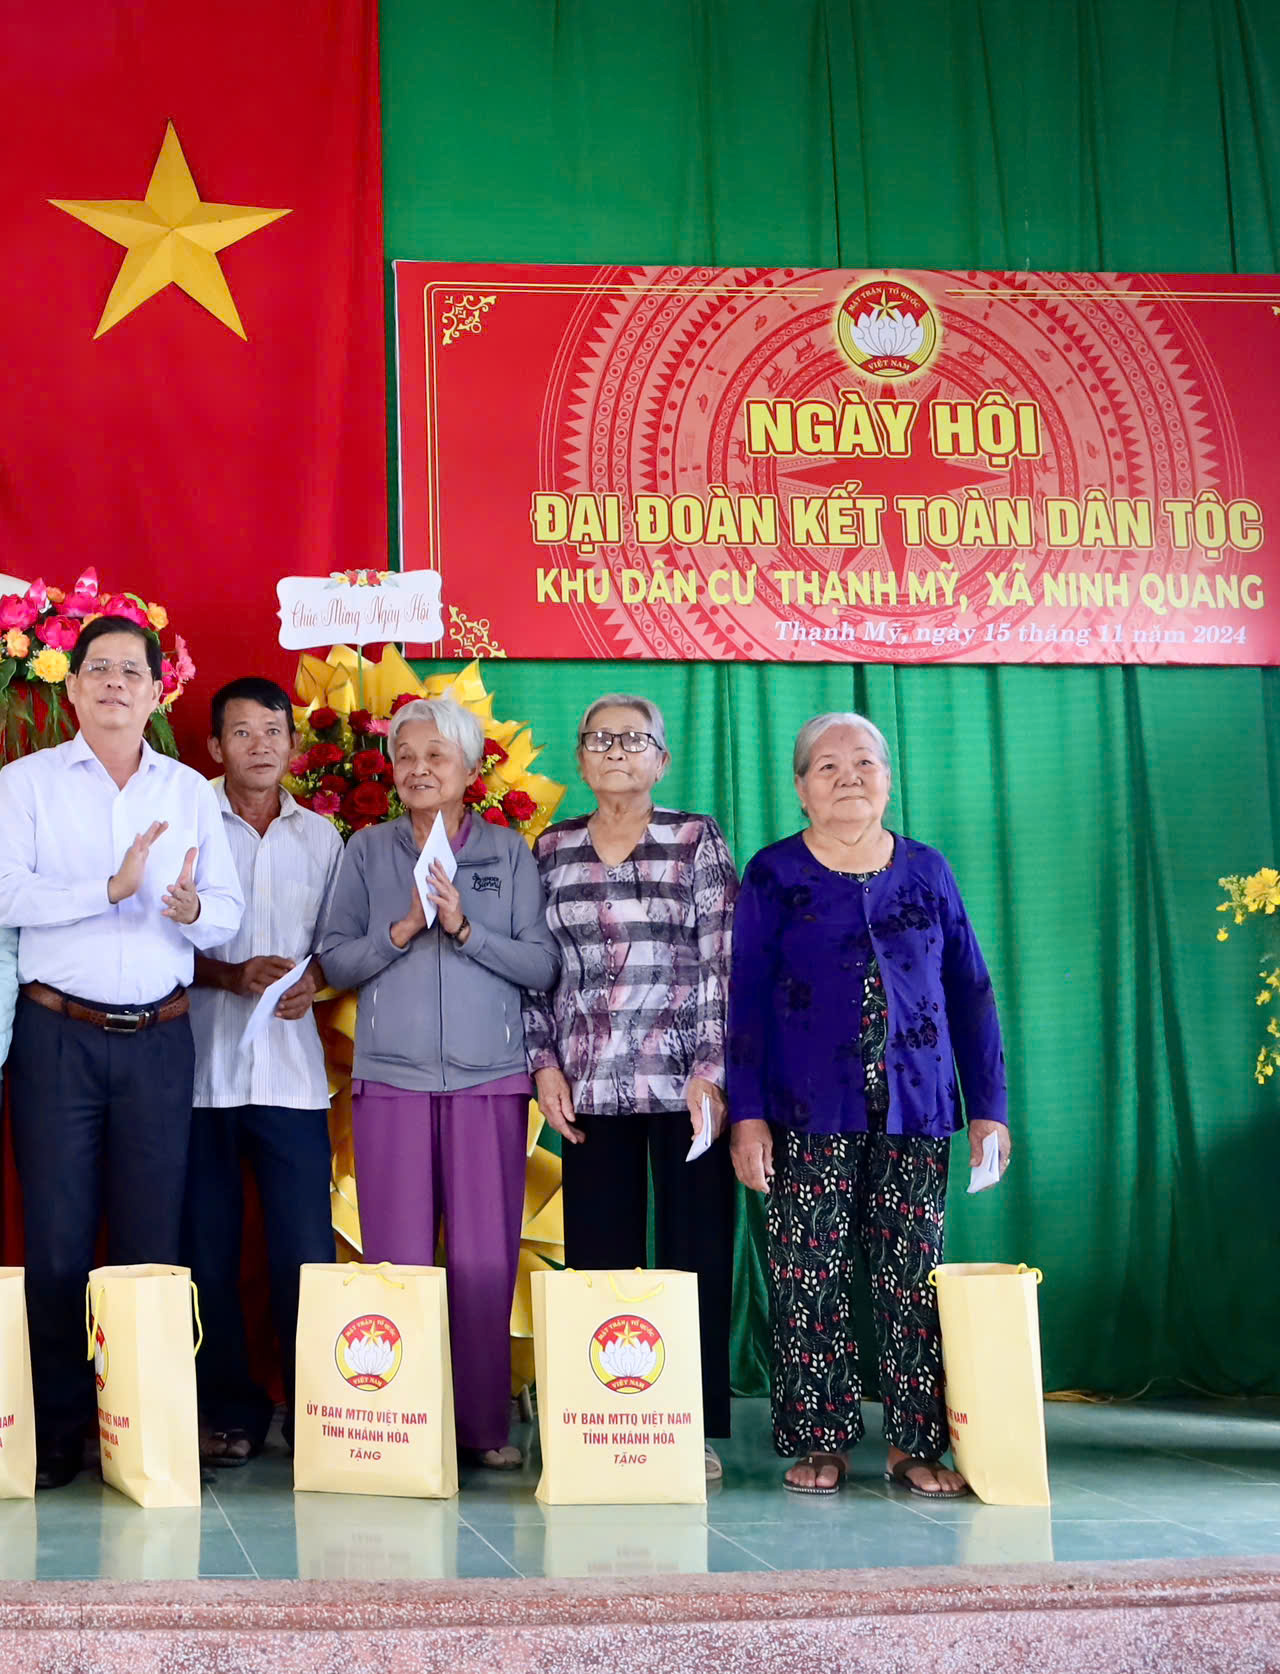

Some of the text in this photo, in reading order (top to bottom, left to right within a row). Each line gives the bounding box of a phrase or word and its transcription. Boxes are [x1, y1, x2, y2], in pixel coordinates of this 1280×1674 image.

[868, 360, 910, 370] VIỆT NAM
[746, 389, 1042, 470] NGÀY HỘI
[532, 481, 1264, 561] ĐẠI ĐOÀN KẾT TOÀN DÂN TỘC
[536, 560, 1265, 615] KHU DÂN CƯ THẠNH MỸ, XÃ NINH QUANG
[775, 621, 1247, 646] Thạnh Mỹ, ngày 15 tháng 11 năm 2024
[306, 1400, 428, 1426] ỦY BAN MTTQ VIỆT NAM
[563, 1408, 692, 1428] ỦY BAN MTTQ VIỆT NAM
[322, 1422, 410, 1443] TỈNH KHÁNH HÒA
[582, 1428, 675, 1444] TỈNH KHÁNH HÒA
[349, 1447, 382, 1462] TẶNG
[614, 1451, 647, 1467] TẶNG
